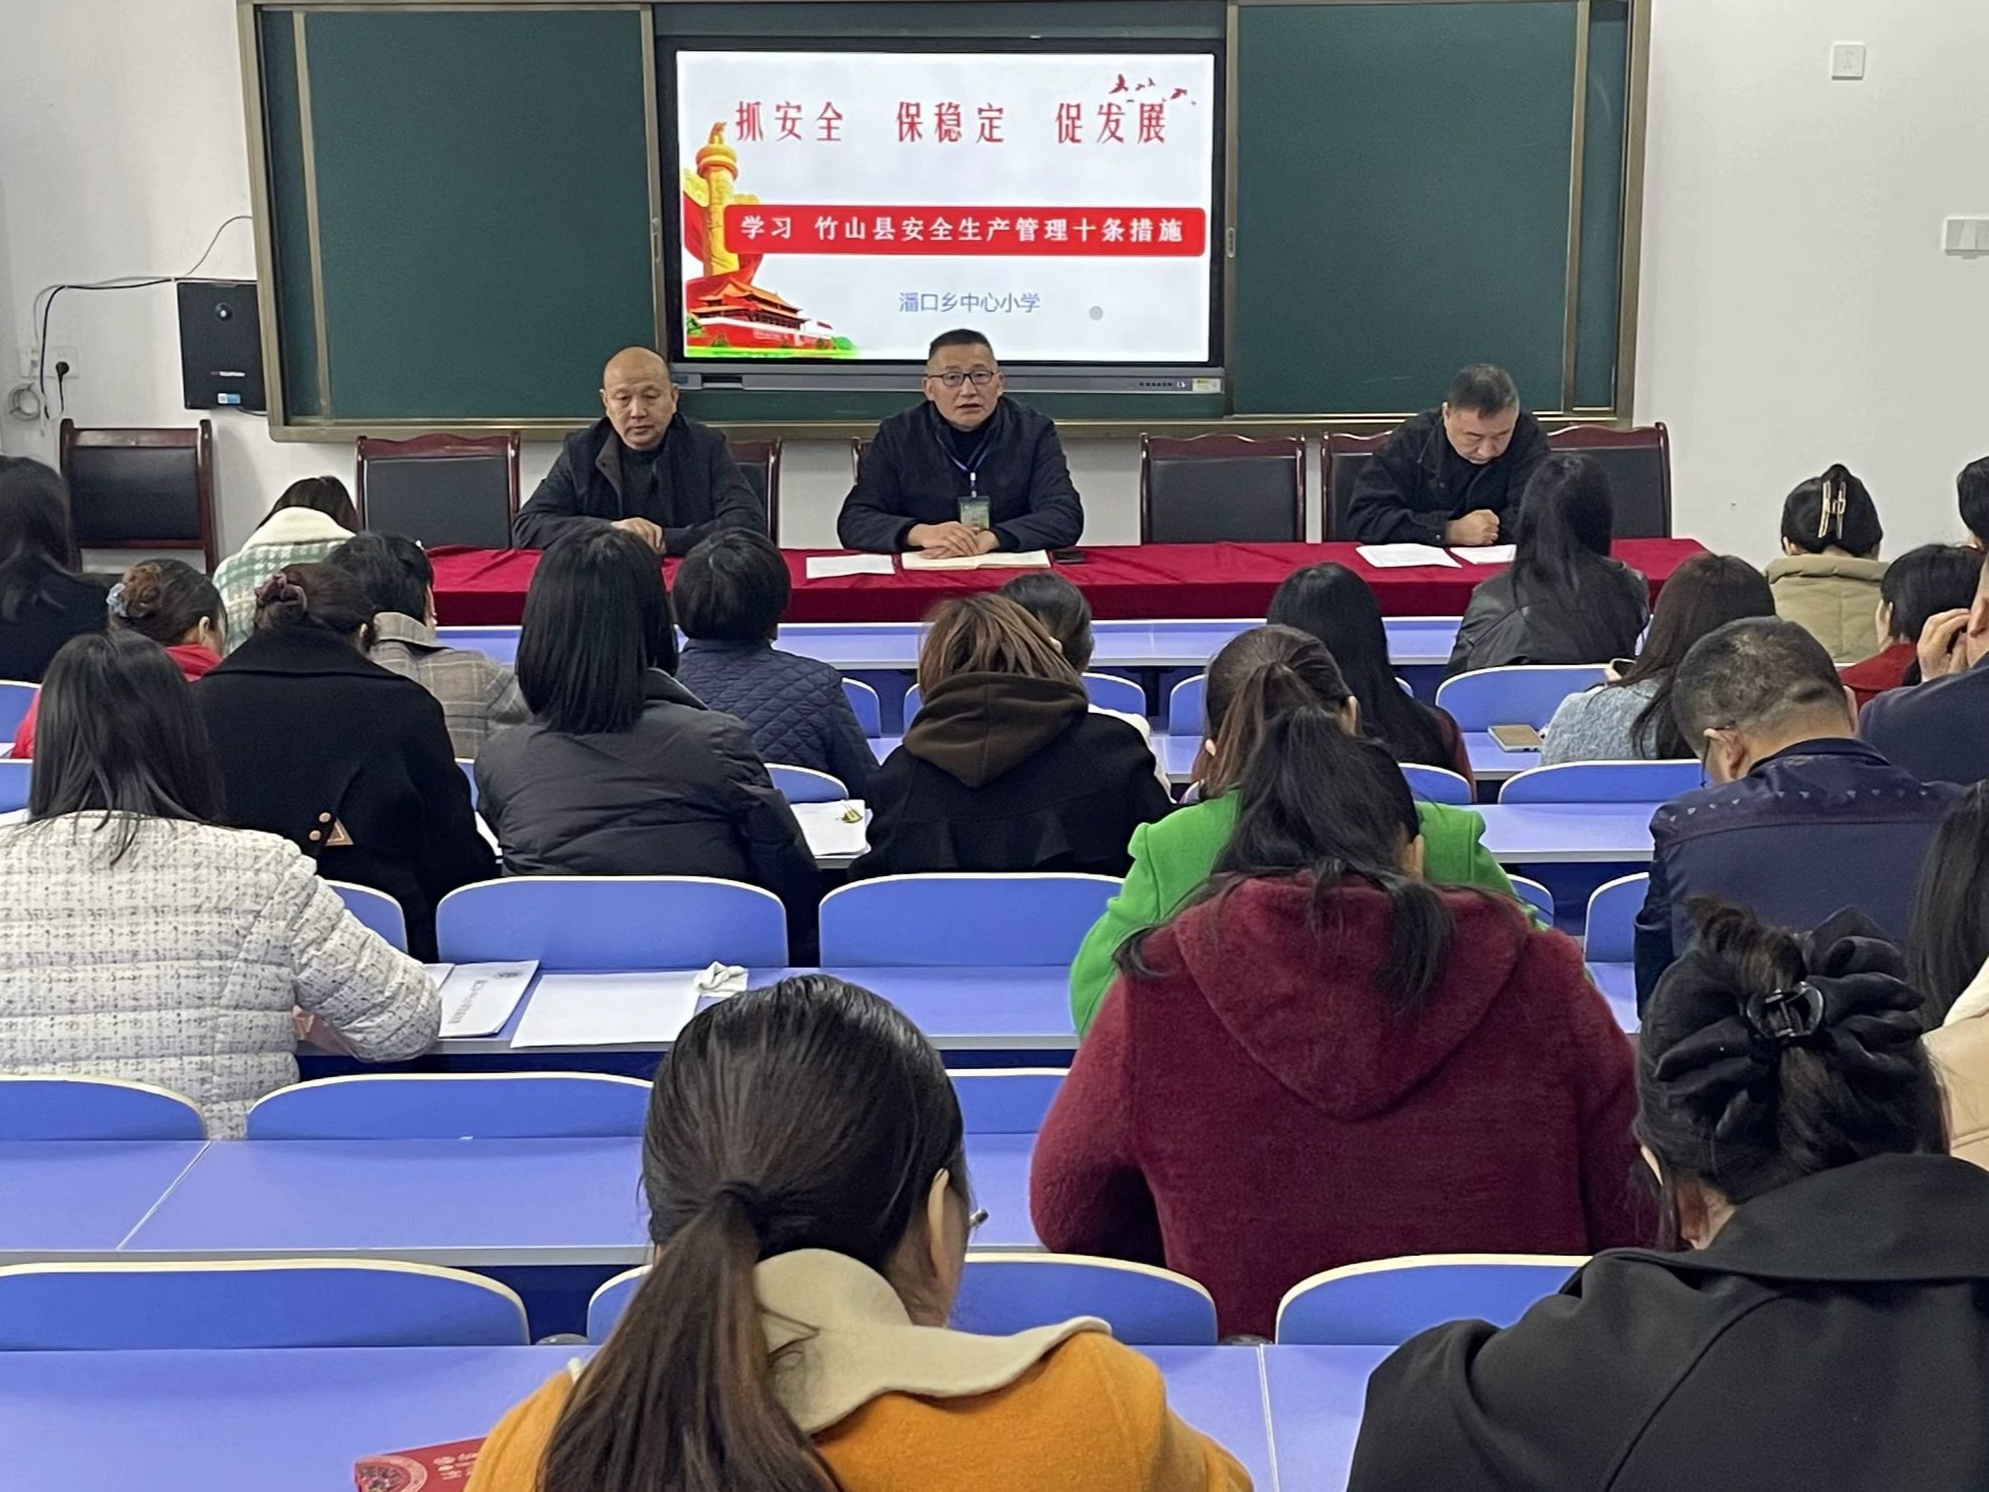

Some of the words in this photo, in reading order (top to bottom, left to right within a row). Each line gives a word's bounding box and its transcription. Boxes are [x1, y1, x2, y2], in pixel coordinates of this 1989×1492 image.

[735, 101, 844, 142] 抓安全
[895, 101, 1004, 143] 保稳定
[1054, 102, 1166, 144] 促发展
[740, 215, 792, 240] 学习
[814, 215, 1184, 243] 竹山县安全生产管理十条措施
[898, 291, 1041, 314] 潘口乡中心小学
